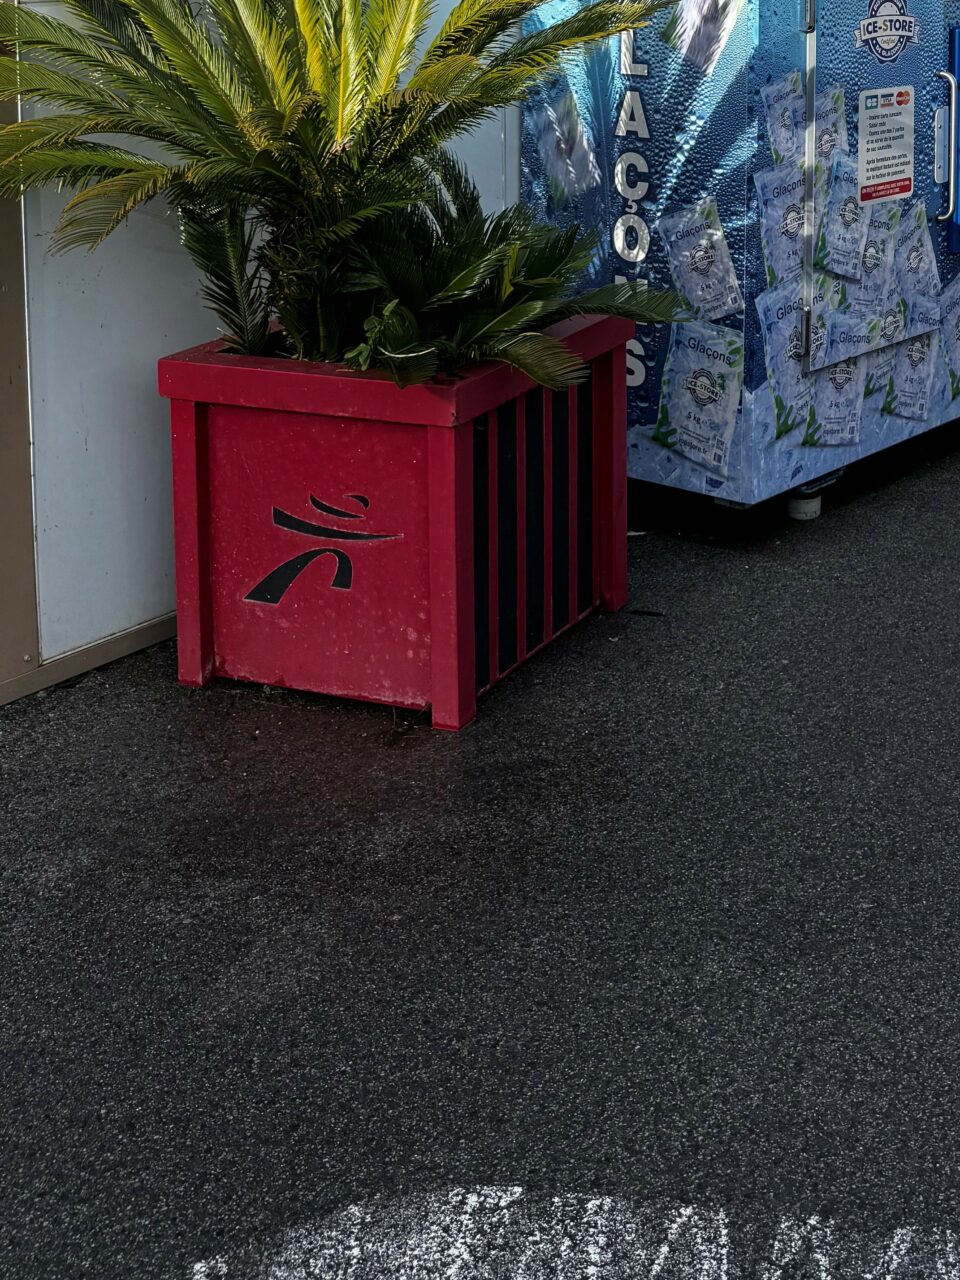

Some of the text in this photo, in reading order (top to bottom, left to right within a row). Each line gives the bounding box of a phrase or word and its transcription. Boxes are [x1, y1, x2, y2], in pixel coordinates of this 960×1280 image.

[862, 18, 913, 36] ICE-STORE
[676, 222, 710, 240] Glaçons
[840, 331, 871, 346] Glaçons
[688, 337, 732, 365] Glaçons
